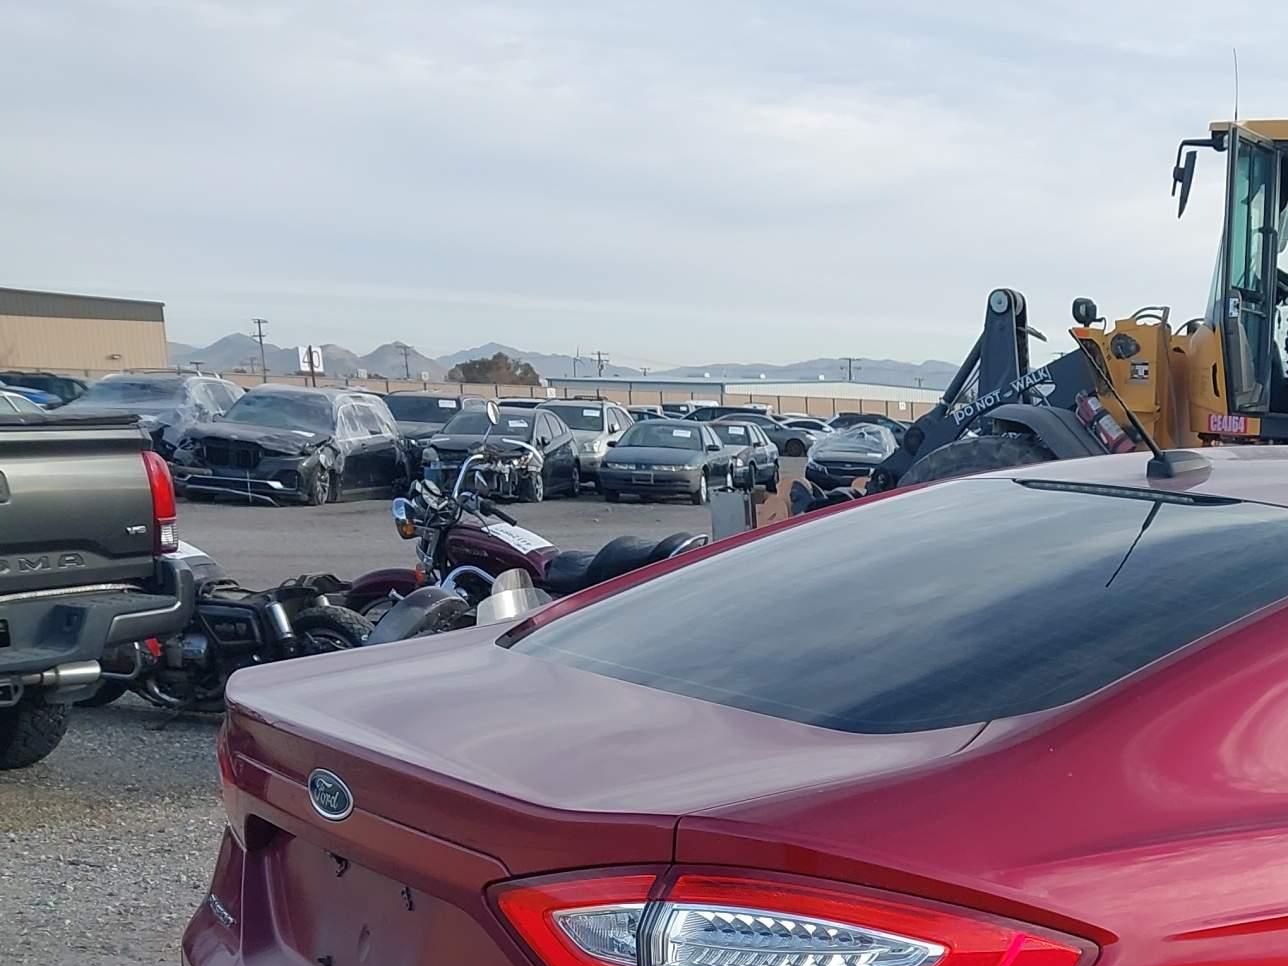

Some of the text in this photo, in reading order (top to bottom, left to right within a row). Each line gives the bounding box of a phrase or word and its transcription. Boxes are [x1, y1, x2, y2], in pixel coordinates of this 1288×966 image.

[302, 350, 321, 368] 40
[955, 368, 1049, 421] DO NOT WALK
[314, 778, 340, 809] Ford
